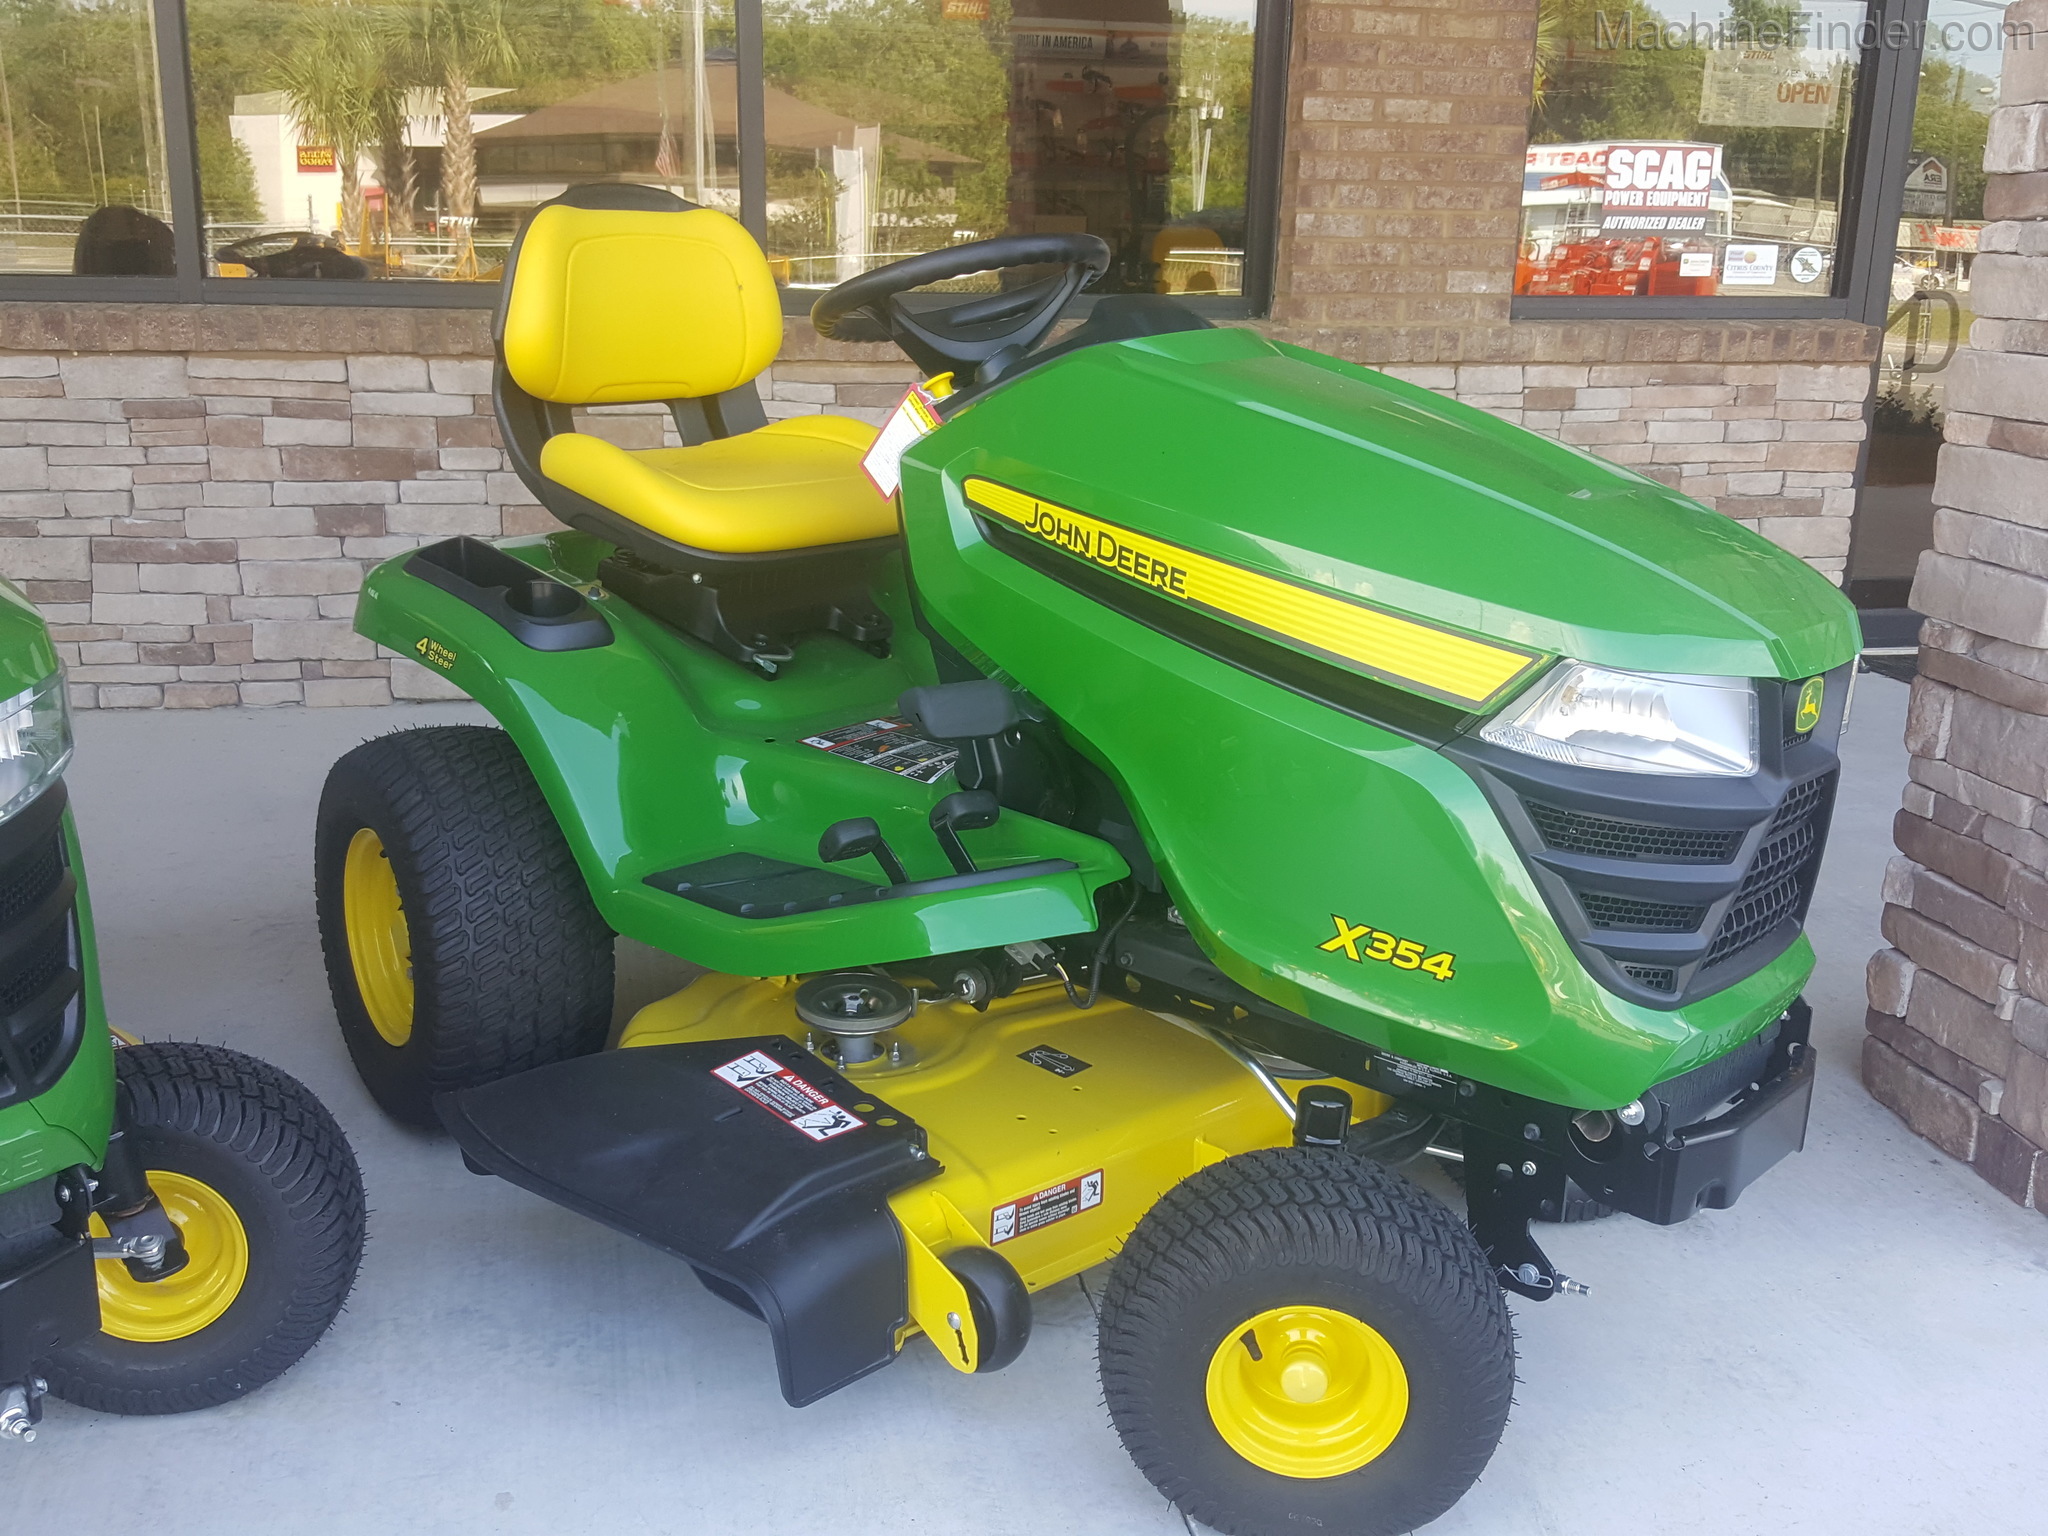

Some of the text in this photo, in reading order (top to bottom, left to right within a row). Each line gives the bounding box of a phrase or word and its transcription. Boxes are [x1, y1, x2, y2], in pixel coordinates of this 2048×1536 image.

[946, 2, 986, 15] STIHL
[1042, 35, 1052, 48] IN
[1053, 36, 1093, 49] AMERICA
[1776, 81, 1832, 105] OPEN
[1606, 149, 1712, 190] SCAG
[1604, 191, 1709, 208] POWER EQUIPMENT
[1602, 216, 1706, 230] AUTHORIZED DEALER
[1025, 503, 1188, 595] JOHN DEERE
[416, 637, 457, 662] 4 Wheel
[428, 650, 454, 670] Steer
[1315, 913, 1457, 982] X354
[792, 1079, 829, 1105] DANGER
[1039, 1184, 1066, 1200] DANGER
